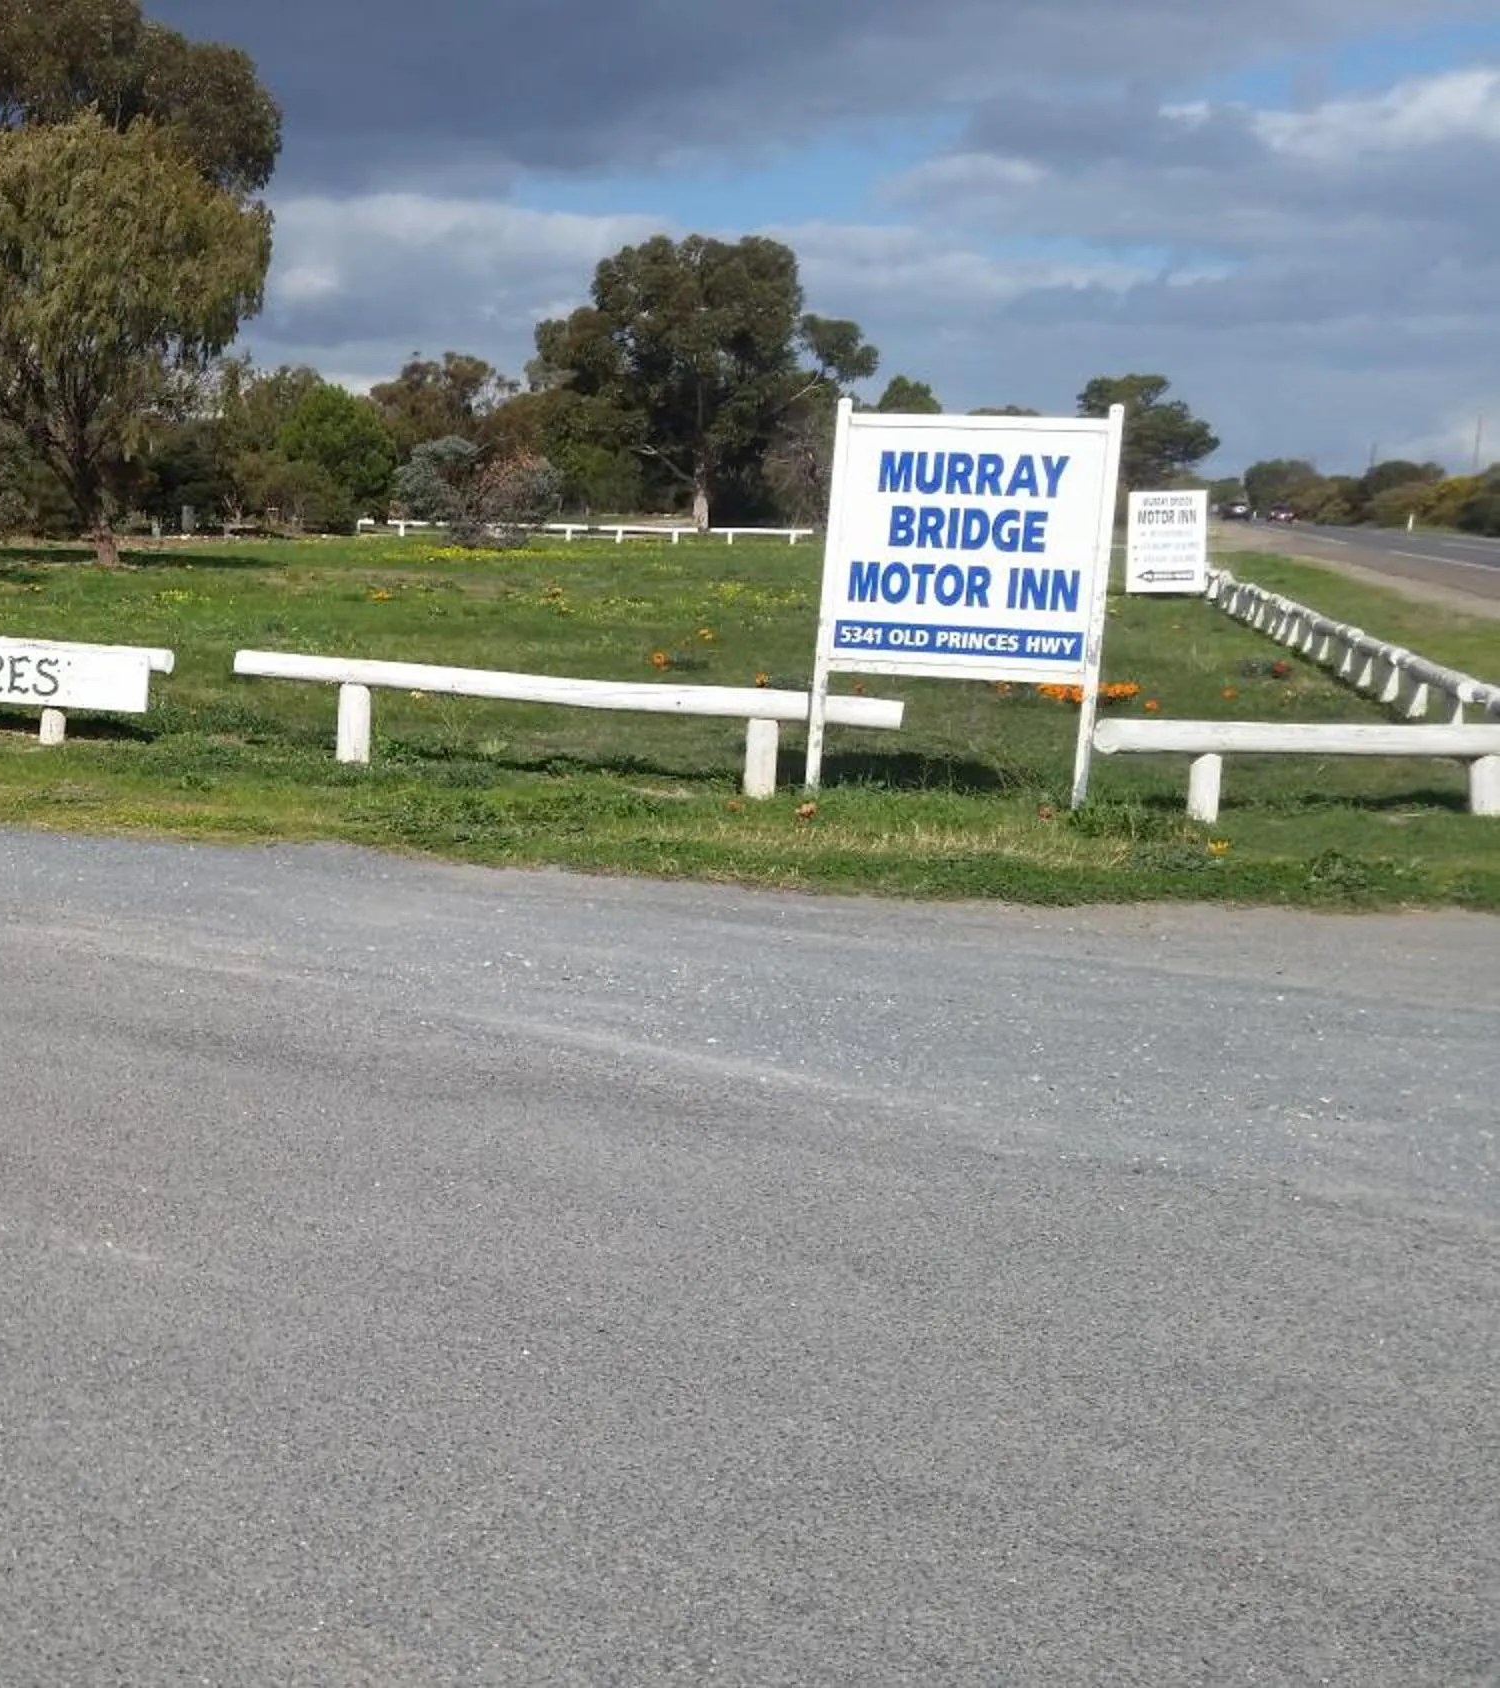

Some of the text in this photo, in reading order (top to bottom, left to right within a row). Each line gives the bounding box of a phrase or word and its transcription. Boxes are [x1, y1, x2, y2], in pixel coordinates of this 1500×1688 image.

[878, 450, 1070, 498] MURRAY
[887, 506, 1049, 553] BRIDGE
[1137, 508, 1197, 525] MOTOR INN
[846, 560, 1081, 612] MOTOR INN
[840, 625, 1077, 655] 5341 OLD PRINCES HWY
